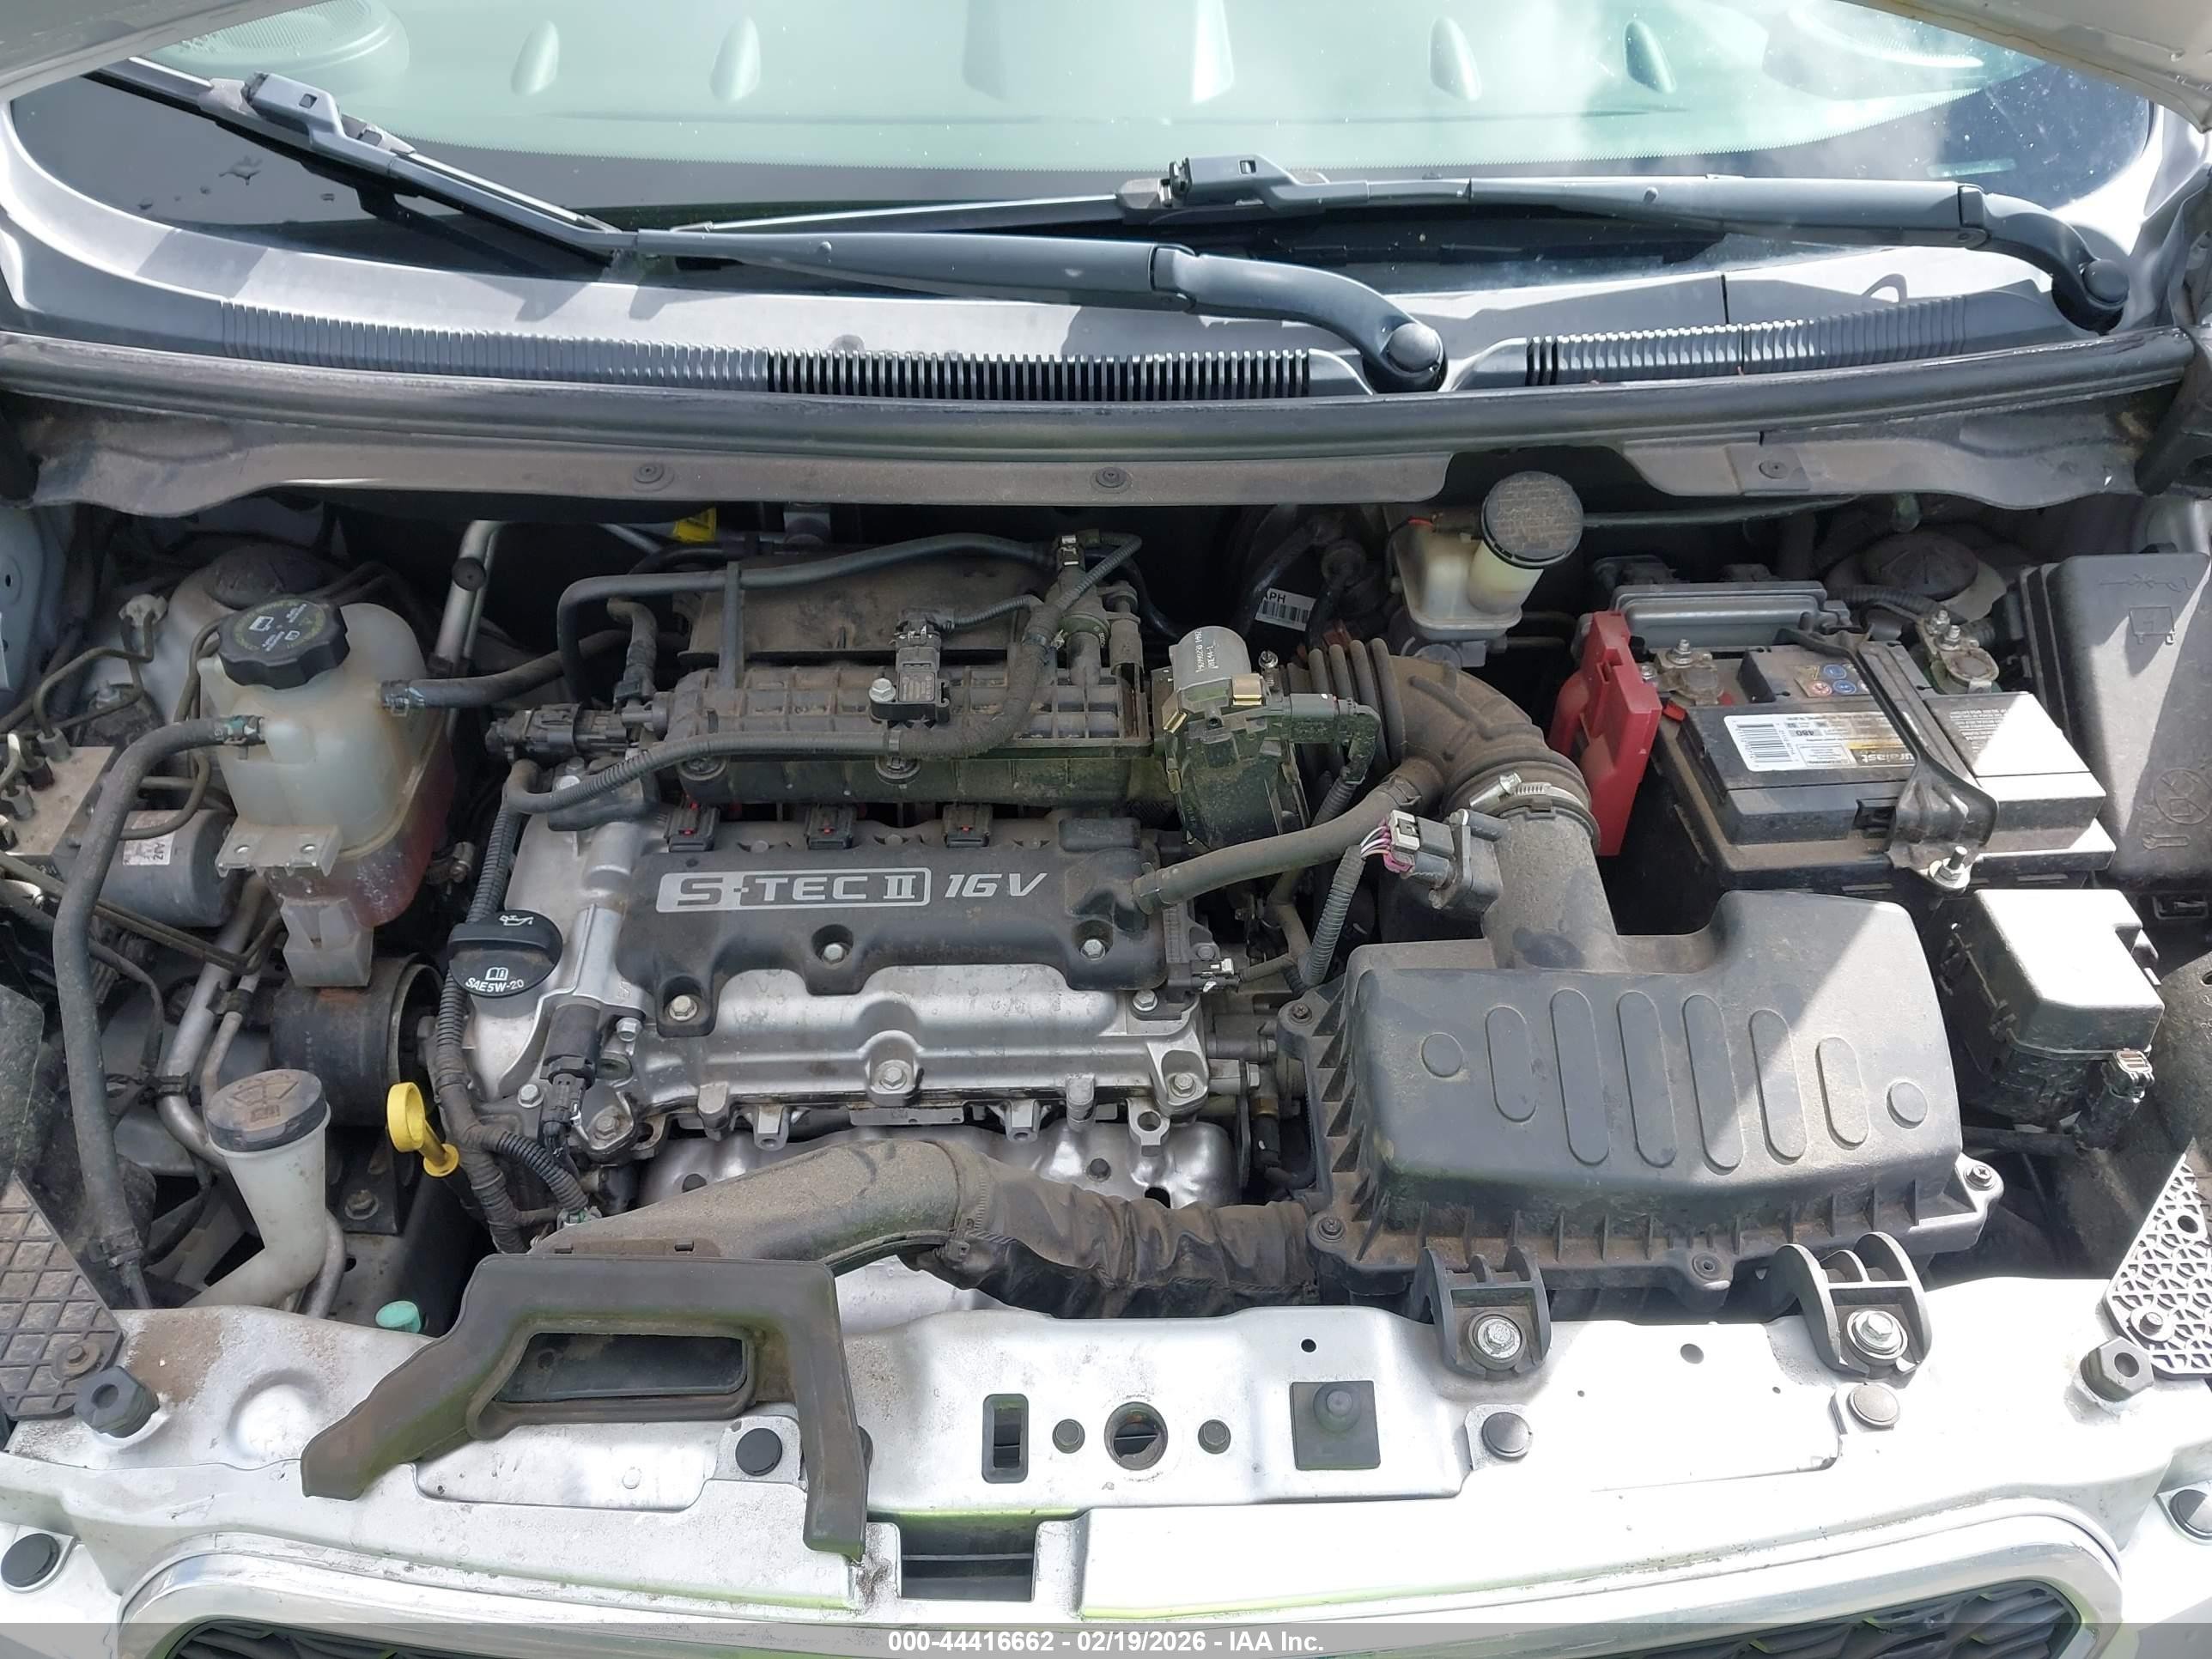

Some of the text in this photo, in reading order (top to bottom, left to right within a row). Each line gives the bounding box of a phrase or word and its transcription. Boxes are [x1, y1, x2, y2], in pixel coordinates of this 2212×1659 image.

[677, 875, 868, 906] S-TEC
[944, 872, 1048, 898] 16V
[465, 977, 525, 993] SAE5W-20
